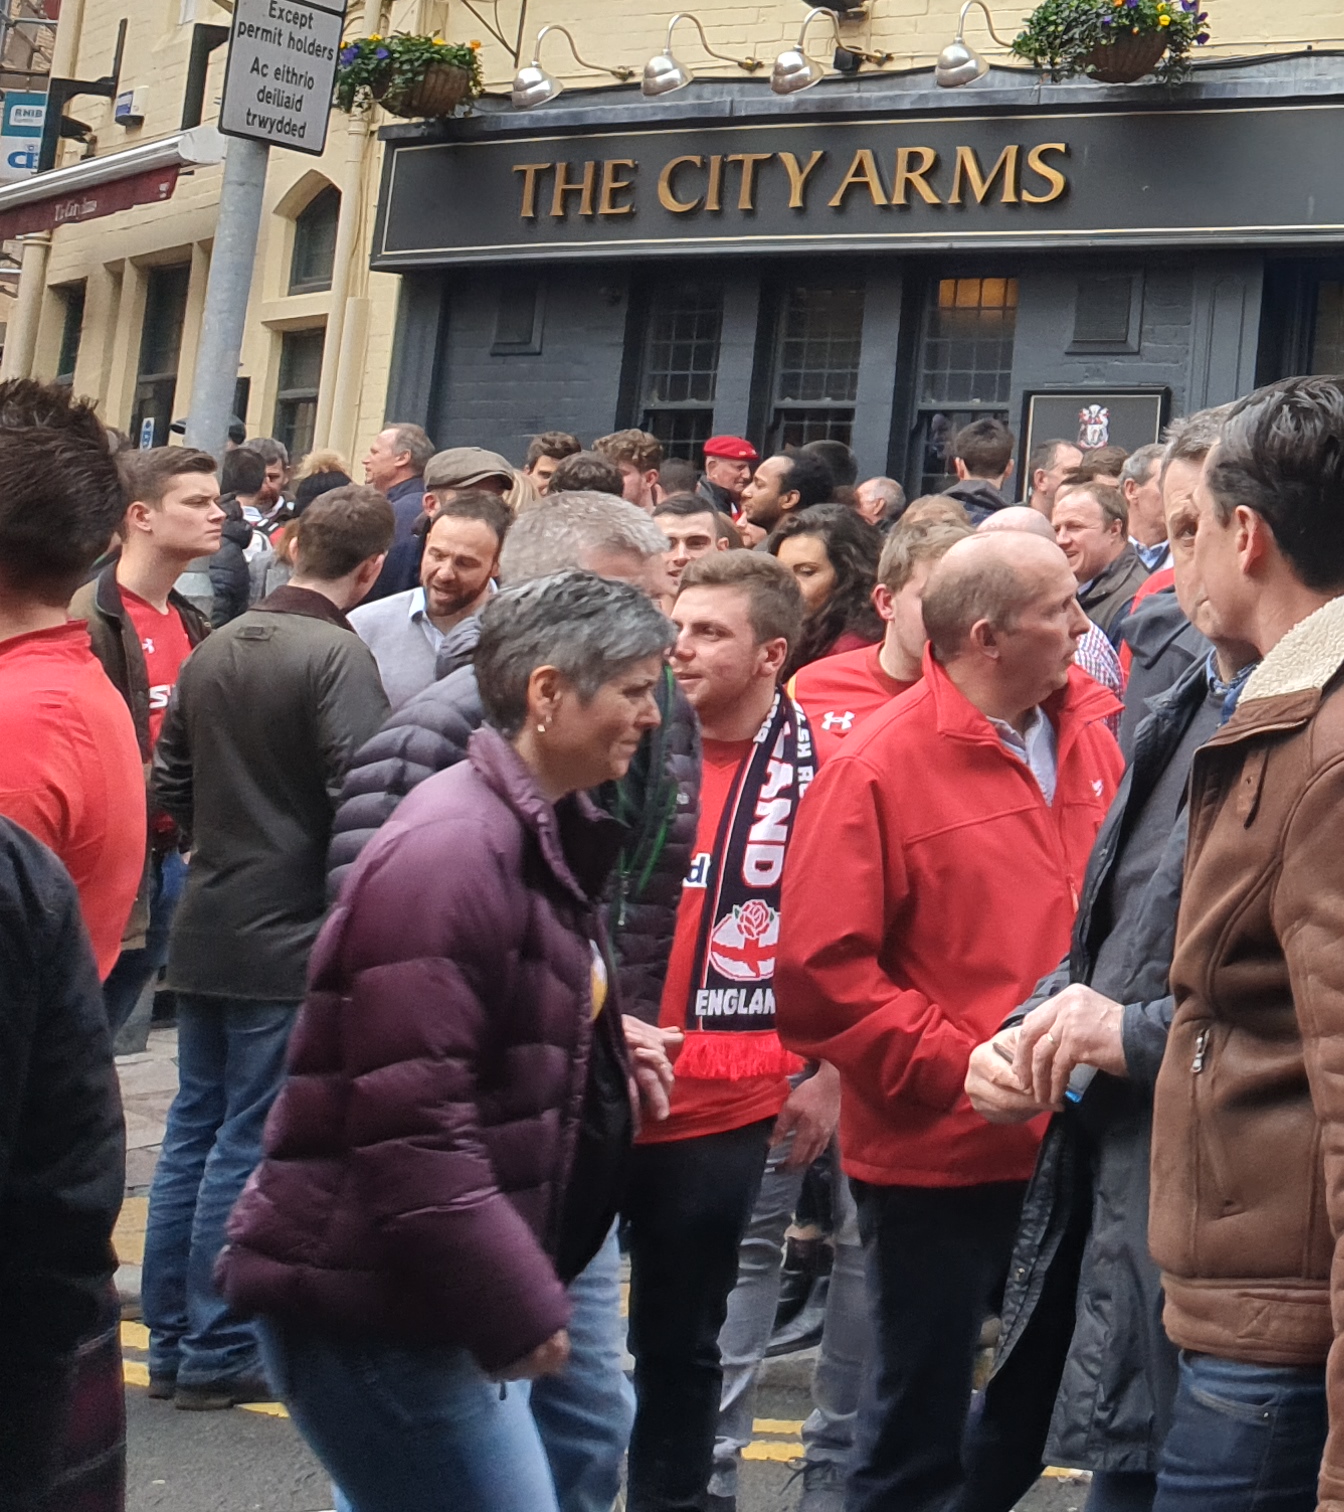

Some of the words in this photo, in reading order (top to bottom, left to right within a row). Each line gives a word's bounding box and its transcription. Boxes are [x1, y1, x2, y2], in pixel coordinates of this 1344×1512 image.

[268, 0, 314, 30] Except
[236, 20, 284, 48] permit
[287, 33, 334, 62] holders
[250, 56, 269, 78] Ac
[274, 64, 315, 90] eithrio
[14, 108, 43, 118] RNIB
[256, 86, 303, 113] deiliaid
[245, 108, 307, 139] trwydded
[512, 158, 638, 218] THE
[657, 149, 825, 214] CITY
[828, 142, 1071, 207] ARMS
